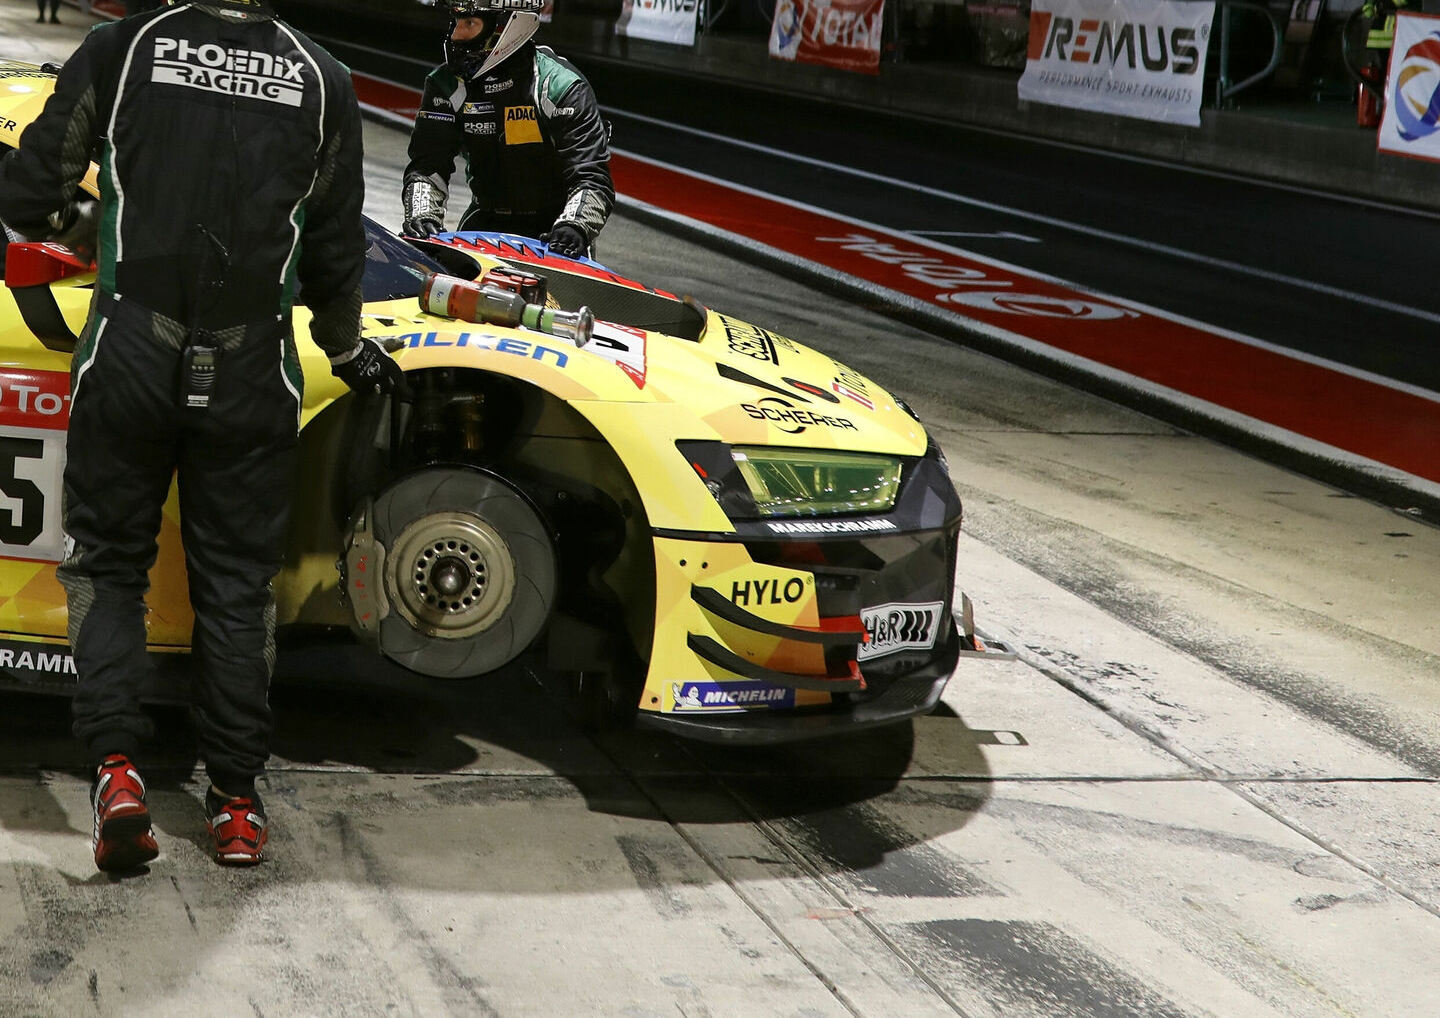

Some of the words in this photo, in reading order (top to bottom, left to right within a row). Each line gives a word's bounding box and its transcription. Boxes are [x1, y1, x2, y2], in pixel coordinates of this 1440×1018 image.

[154, 37, 304, 83] PHOENIX
[1045, 16, 1200, 76] REMUS
[176, 65, 283, 99] RACING
[1039, 70, 1102, 92] PERFORMANCE
[1107, 79, 1137, 96] SPORT
[1141, 84, 1193, 104] EXHAUSTS
[740, 403, 860, 432] SCHERER
[766, 519, 898, 534] MAREKSCHRAMM
[731, 577, 804, 606] HYLO
[704, 688, 786, 704] MICHELIN
